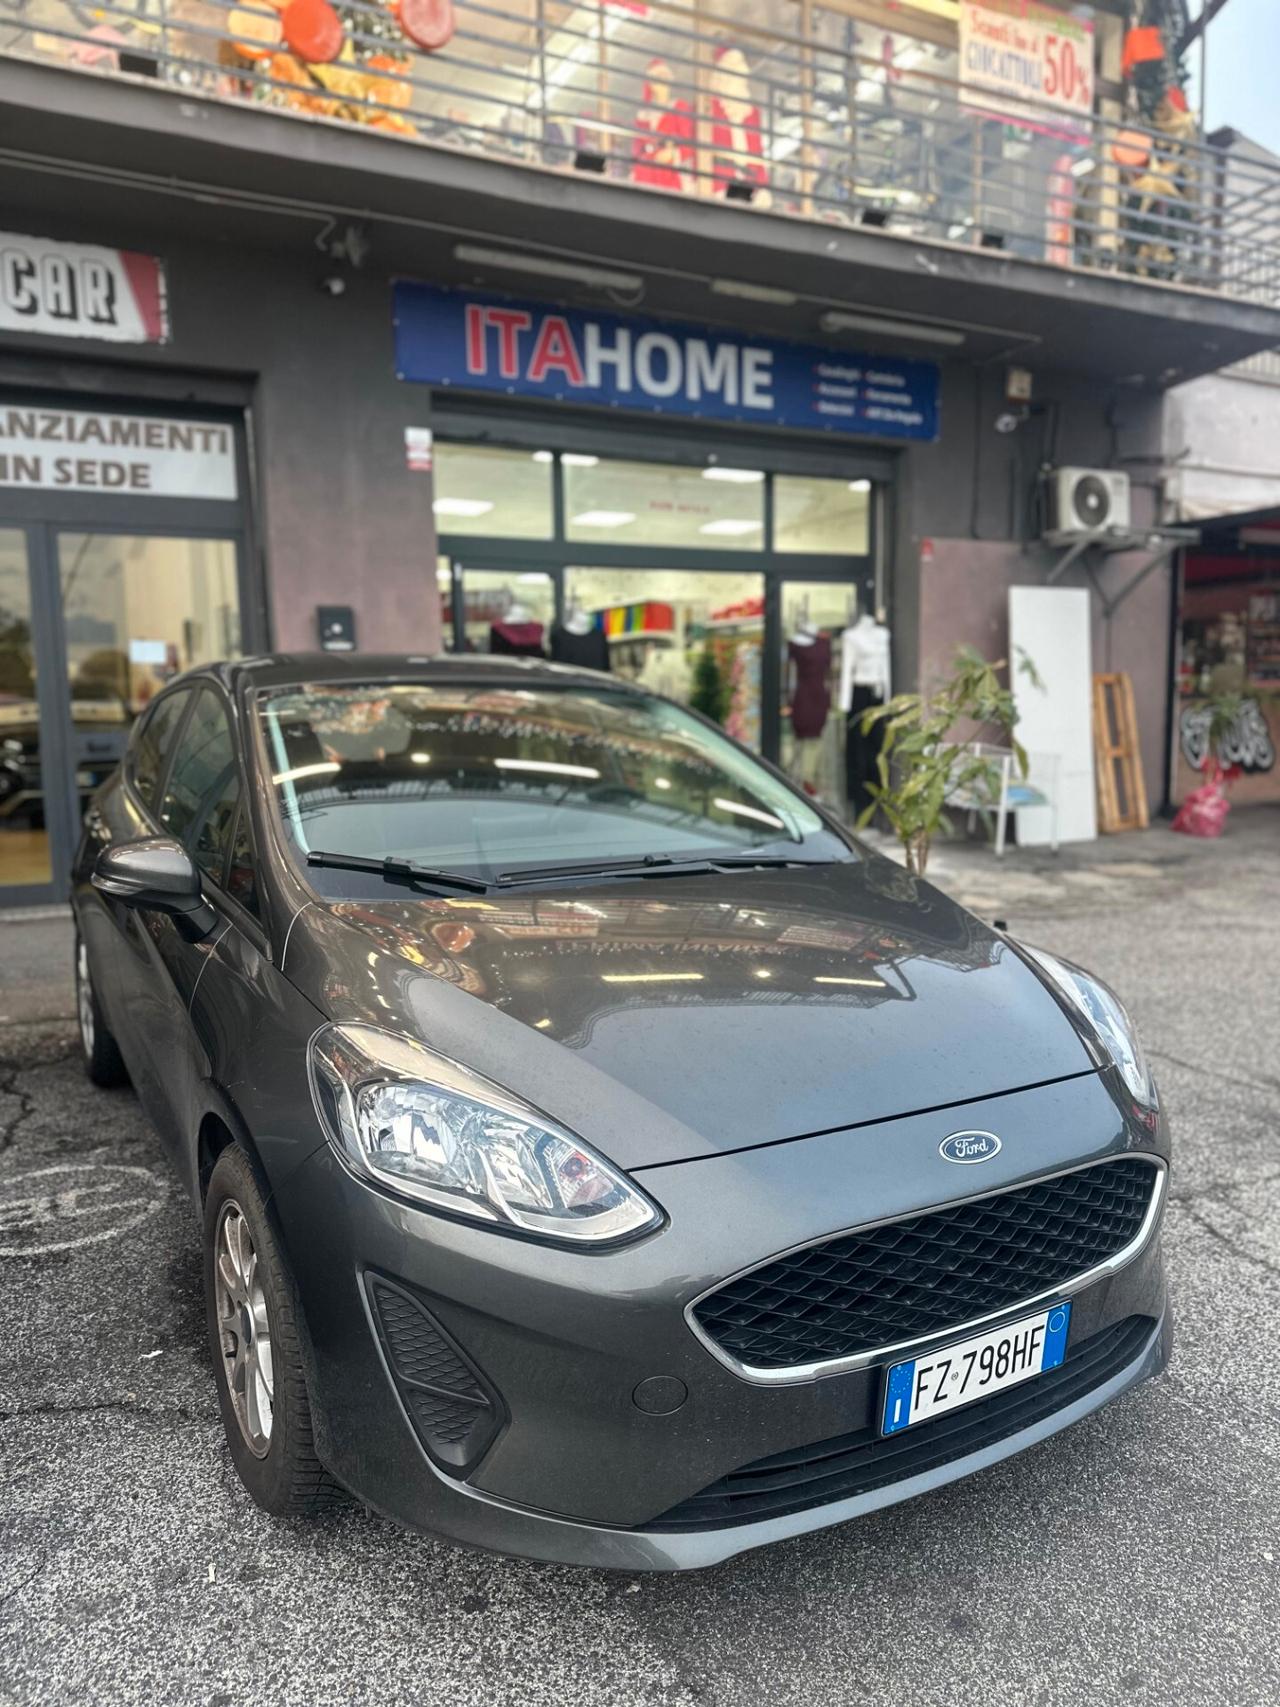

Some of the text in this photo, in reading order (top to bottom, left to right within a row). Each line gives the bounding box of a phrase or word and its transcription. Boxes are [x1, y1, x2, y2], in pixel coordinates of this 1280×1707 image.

[1044, 34, 1090, 106] 50%
[1, 248, 118, 326] CAR
[465, 303, 775, 411] ITAHOME
[0, 410, 229, 455] NZIAMENTI
[0, 451, 152, 489] IN SEDE
[954, 1136, 989, 1158] Ford
